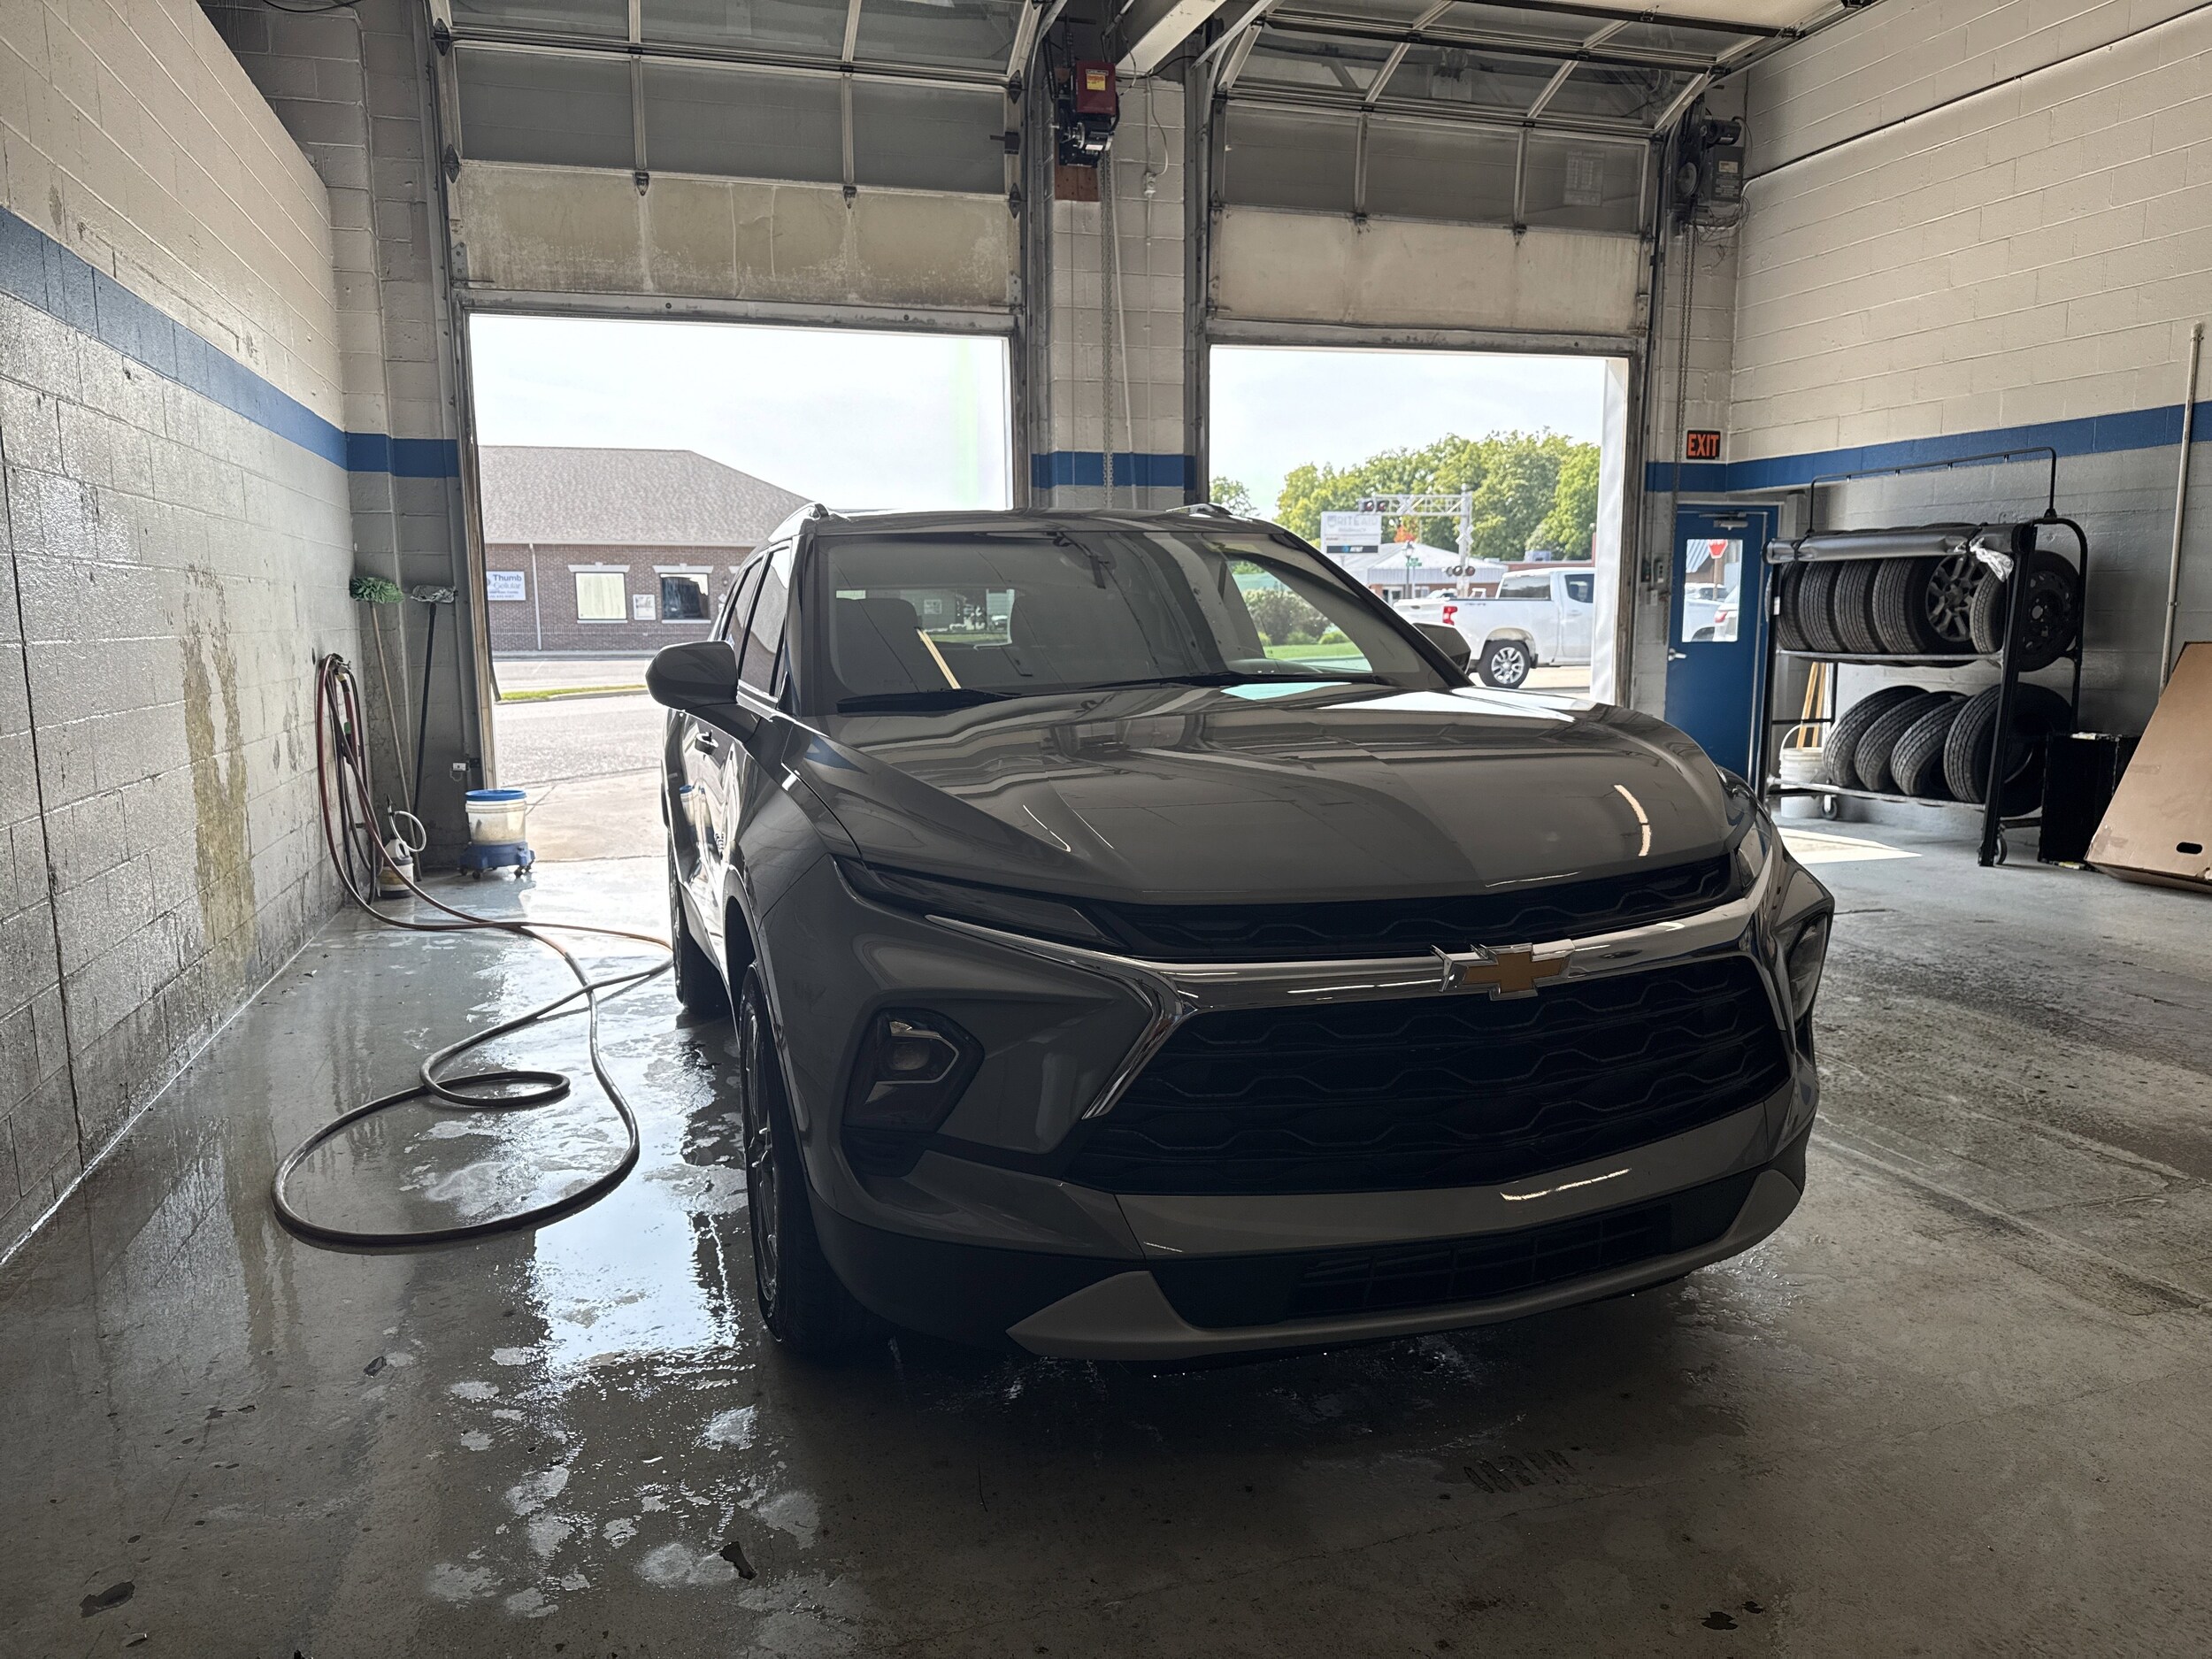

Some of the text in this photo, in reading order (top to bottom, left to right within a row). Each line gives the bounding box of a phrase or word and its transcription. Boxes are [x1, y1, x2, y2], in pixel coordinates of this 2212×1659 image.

[1687, 434, 1719, 457] EXIT
[1338, 516, 1378, 526] RITE AID
